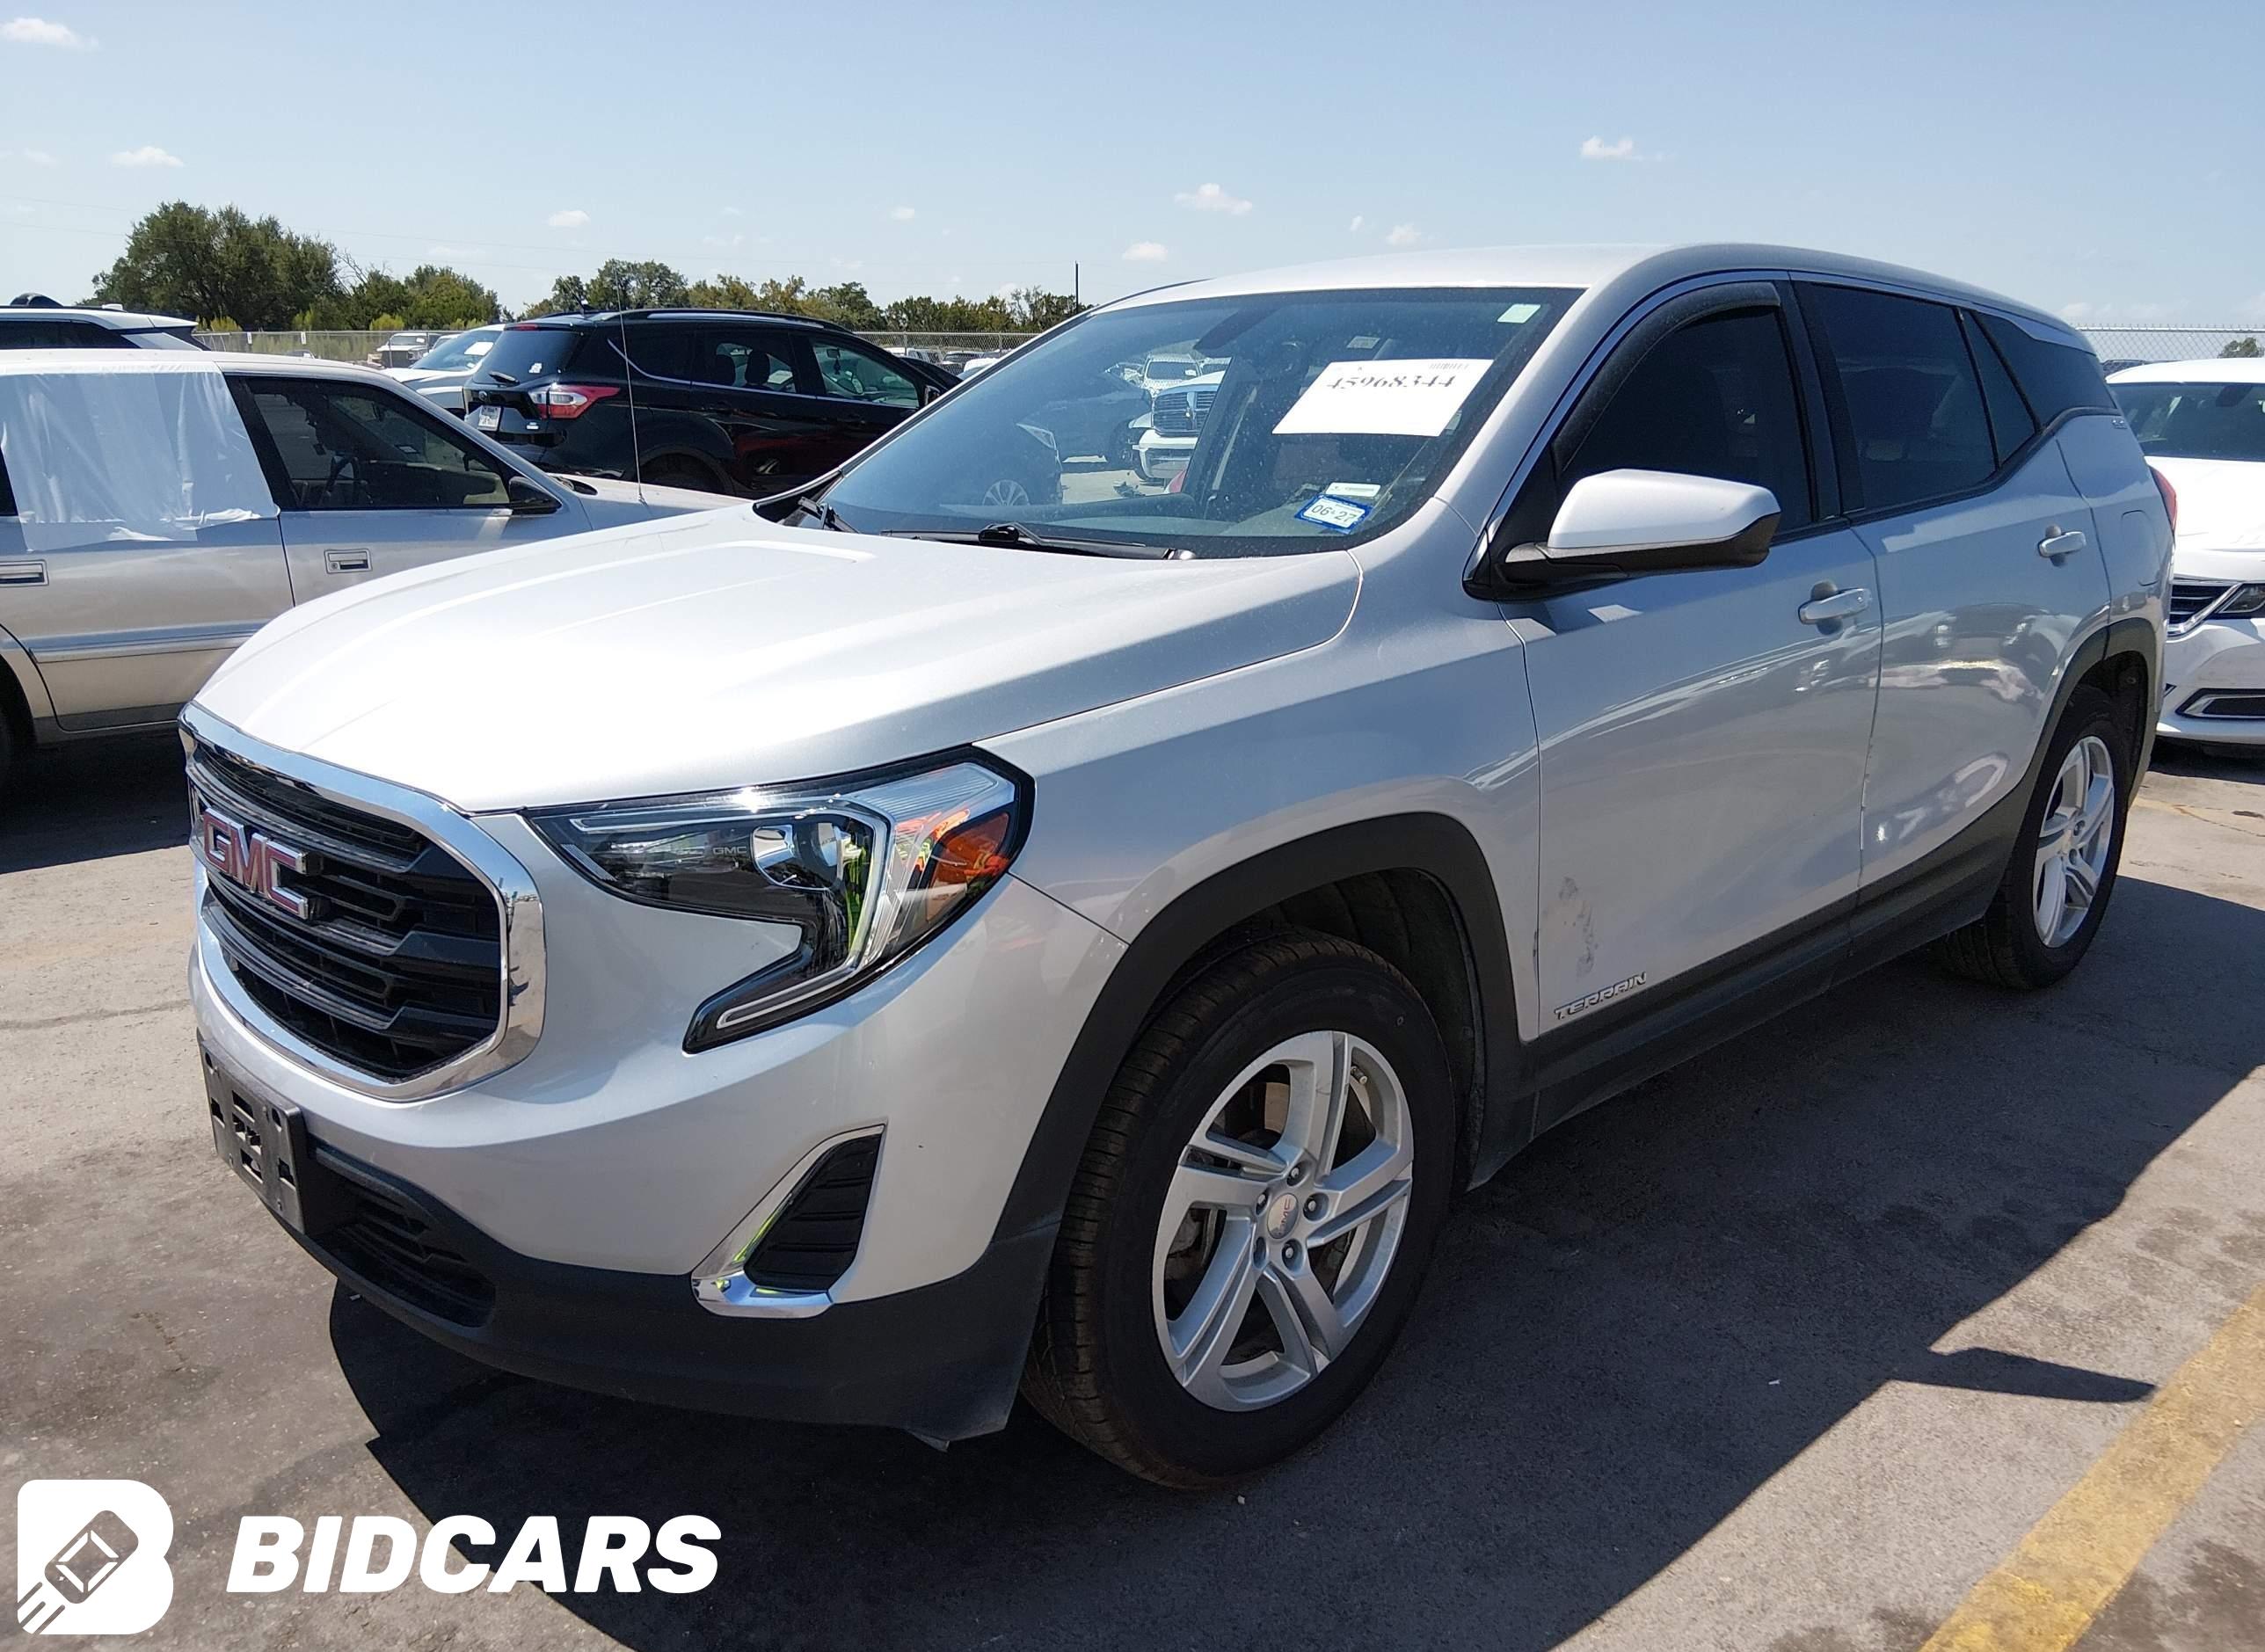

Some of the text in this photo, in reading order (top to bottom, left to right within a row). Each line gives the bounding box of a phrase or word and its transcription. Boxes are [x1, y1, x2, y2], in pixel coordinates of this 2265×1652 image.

[203, 807, 308, 920] GMC
[712, 846, 747, 856] GMC
[1554, 971, 1647, 1020] TERRAIN
